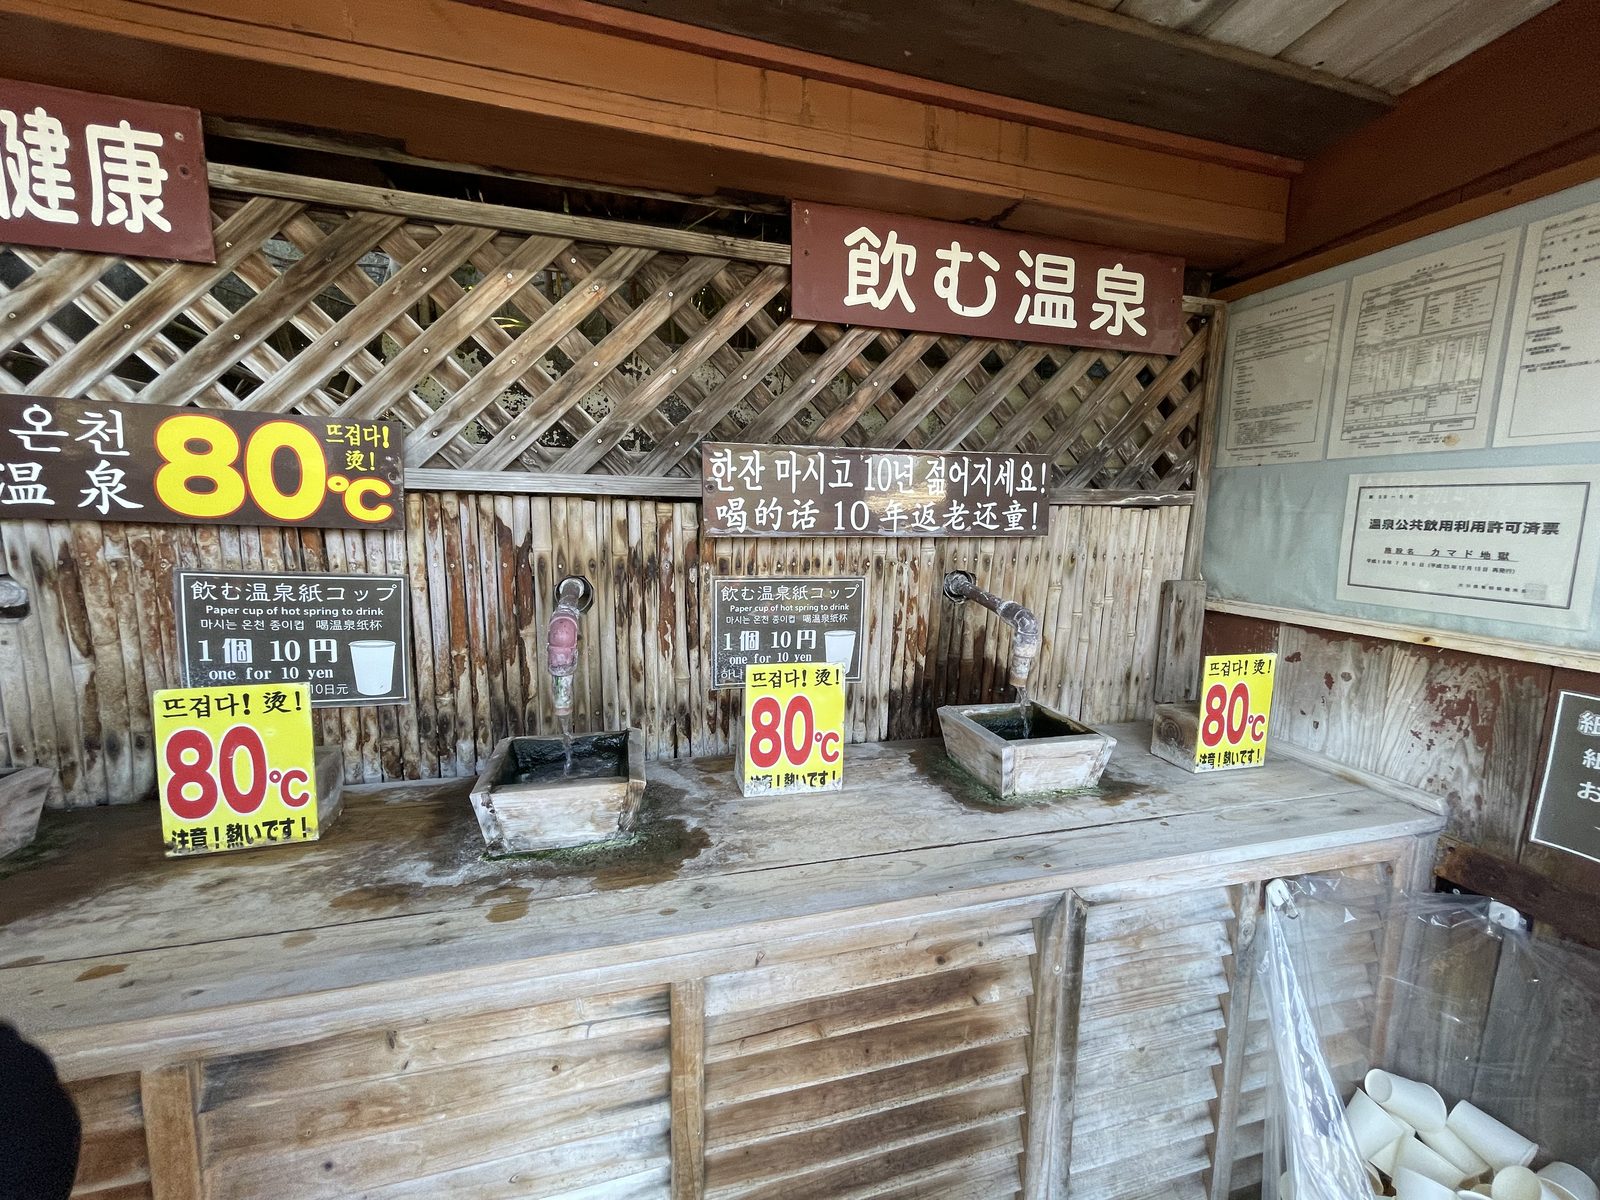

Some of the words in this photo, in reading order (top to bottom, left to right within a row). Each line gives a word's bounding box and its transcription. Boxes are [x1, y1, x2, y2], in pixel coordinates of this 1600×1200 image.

[0, 107, 172, 232] 健康
[843, 226, 1147, 337] 飲む温泉
[709, 448, 766, 492] 한잔
[774, 450, 854, 495] 마시고
[863, 454, 914, 493] 10년
[925, 455, 1047, 496] 젊어지세요!
[1368, 518, 1560, 535] 温泉公共飲用利用許可済票
[190, 580, 398, 602] 飲む温泉紙コップ
[720, 584, 860, 602] 飲む温泉紙コップ
[206, 605, 239, 616] Paper
[242, 608, 263, 616] cup
[266, 606, 278, 615] of
[281, 606, 300, 616] hot
[303, 606, 339, 617] spring
[342, 608, 353, 616] to
[356, 606, 384, 616] drink
[730, 605, 752, 613] Paper
[770, 604, 779, 612] of
[795, 604, 818, 613] spring
[829, 603, 849, 611] drink
[200, 619, 237, 631] 마시는
[241, 619, 265, 631] 온천
[269, 619, 305, 631] 종이컵
[315, 619, 383, 631] 喝温泉纸杯
[729, 654, 748, 665] one
[754, 652, 771, 663] for
[777, 652, 789, 662] 10
[794, 652, 812, 662] yen
[208, 669, 236, 680] one
[246, 667, 272, 680] for
[282, 667, 299, 680] 10
[308, 668, 334, 680] yen
